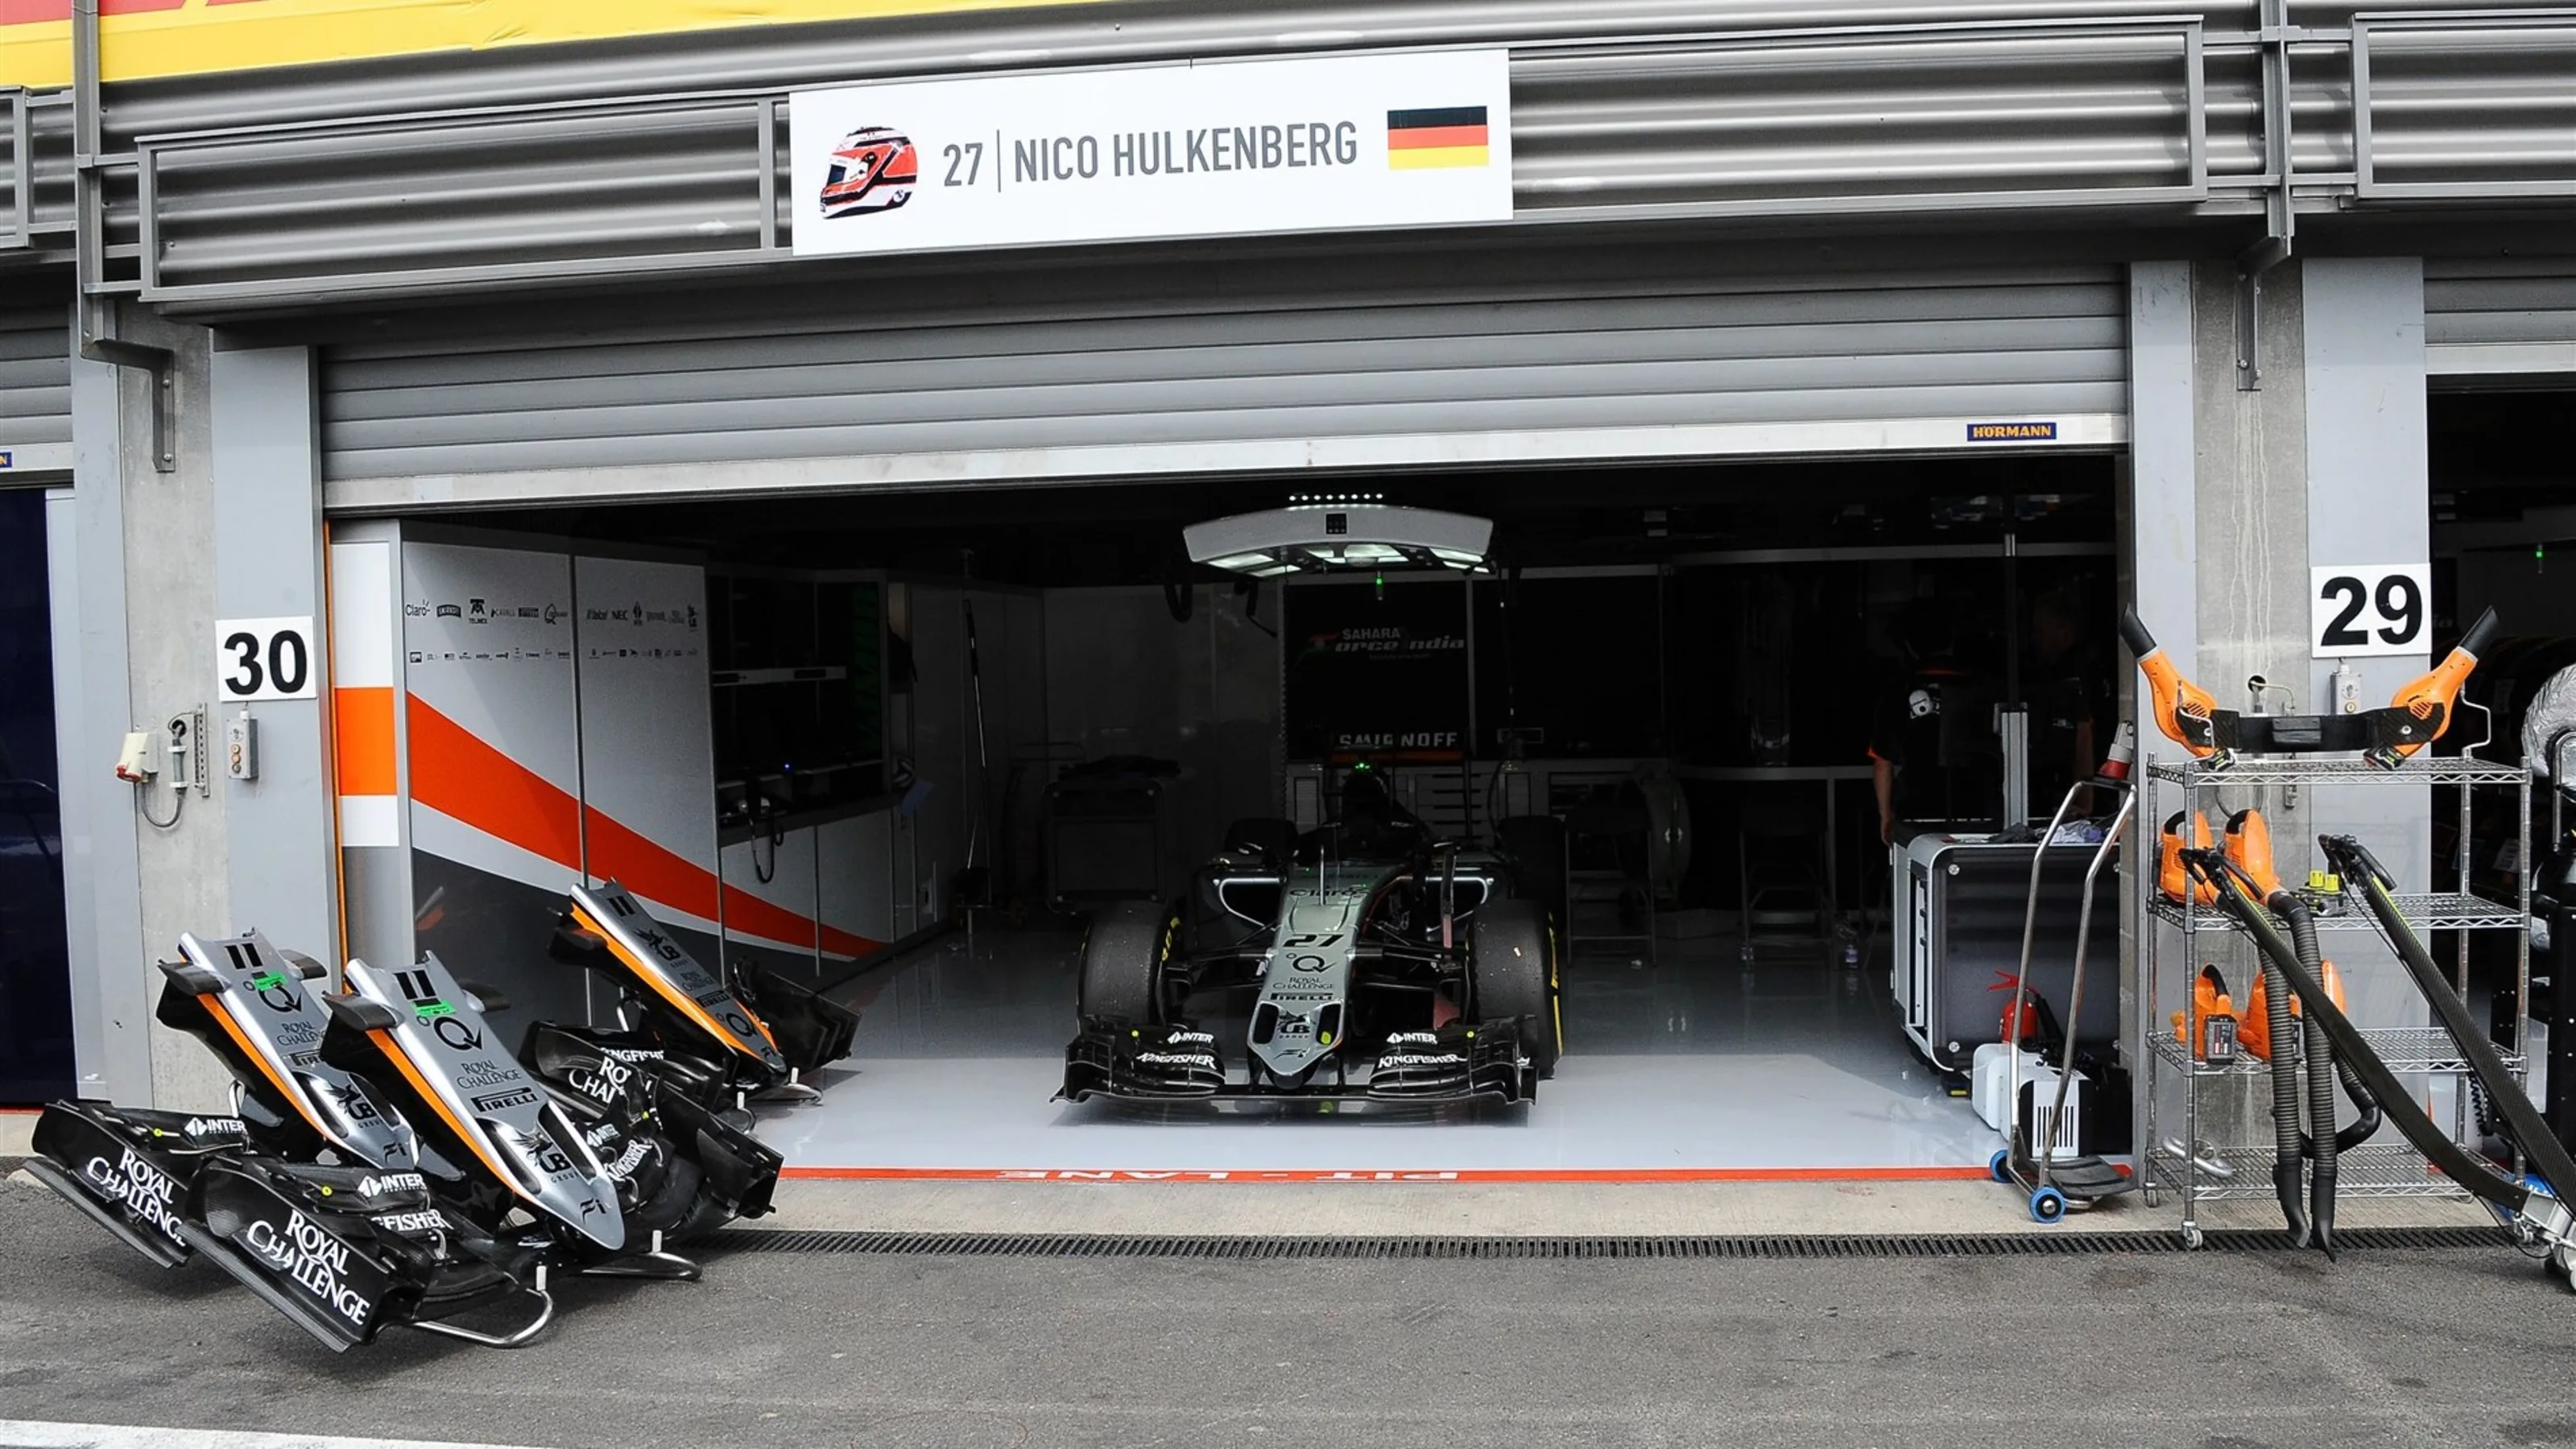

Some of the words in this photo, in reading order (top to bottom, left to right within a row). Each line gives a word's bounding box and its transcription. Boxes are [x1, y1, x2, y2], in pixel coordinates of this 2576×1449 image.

[943, 142, 983, 187] 27
[1015, 135, 1098, 183] NICO
[1114, 121, 1357, 177] HULKENBERG
[612, 610, 628, 621] NEC
[2320, 574, 2423, 646] 29
[1342, 627, 1402, 641] SAHARA
[224, 630, 308, 696] 30
[1282, 933, 1345, 947] 27
[1270, 993, 1333, 1001] PIRELLI
[281, 1021, 316, 1034] ROYAL
[1182, 1032, 1214, 1043] INTER
[1403, 1032, 1437, 1044] INTER
[461, 1060, 499, 1075] ROYAL
[1135, 1052, 1218, 1070] KINGFISHER
[1377, 1054, 1468, 1069] KINGFISHER
[457, 1069, 522, 1089] CHALLENGE
[470, 1087, 539, 1113] PIRELLI
[206, 1119, 247, 1133] INTER
[118, 1146, 174, 1205] ROYAL
[380, 1174, 425, 1189] INTER
[284, 1209, 349, 1276] ROYAL
[246, 1220, 370, 1325] CHALLENGE
